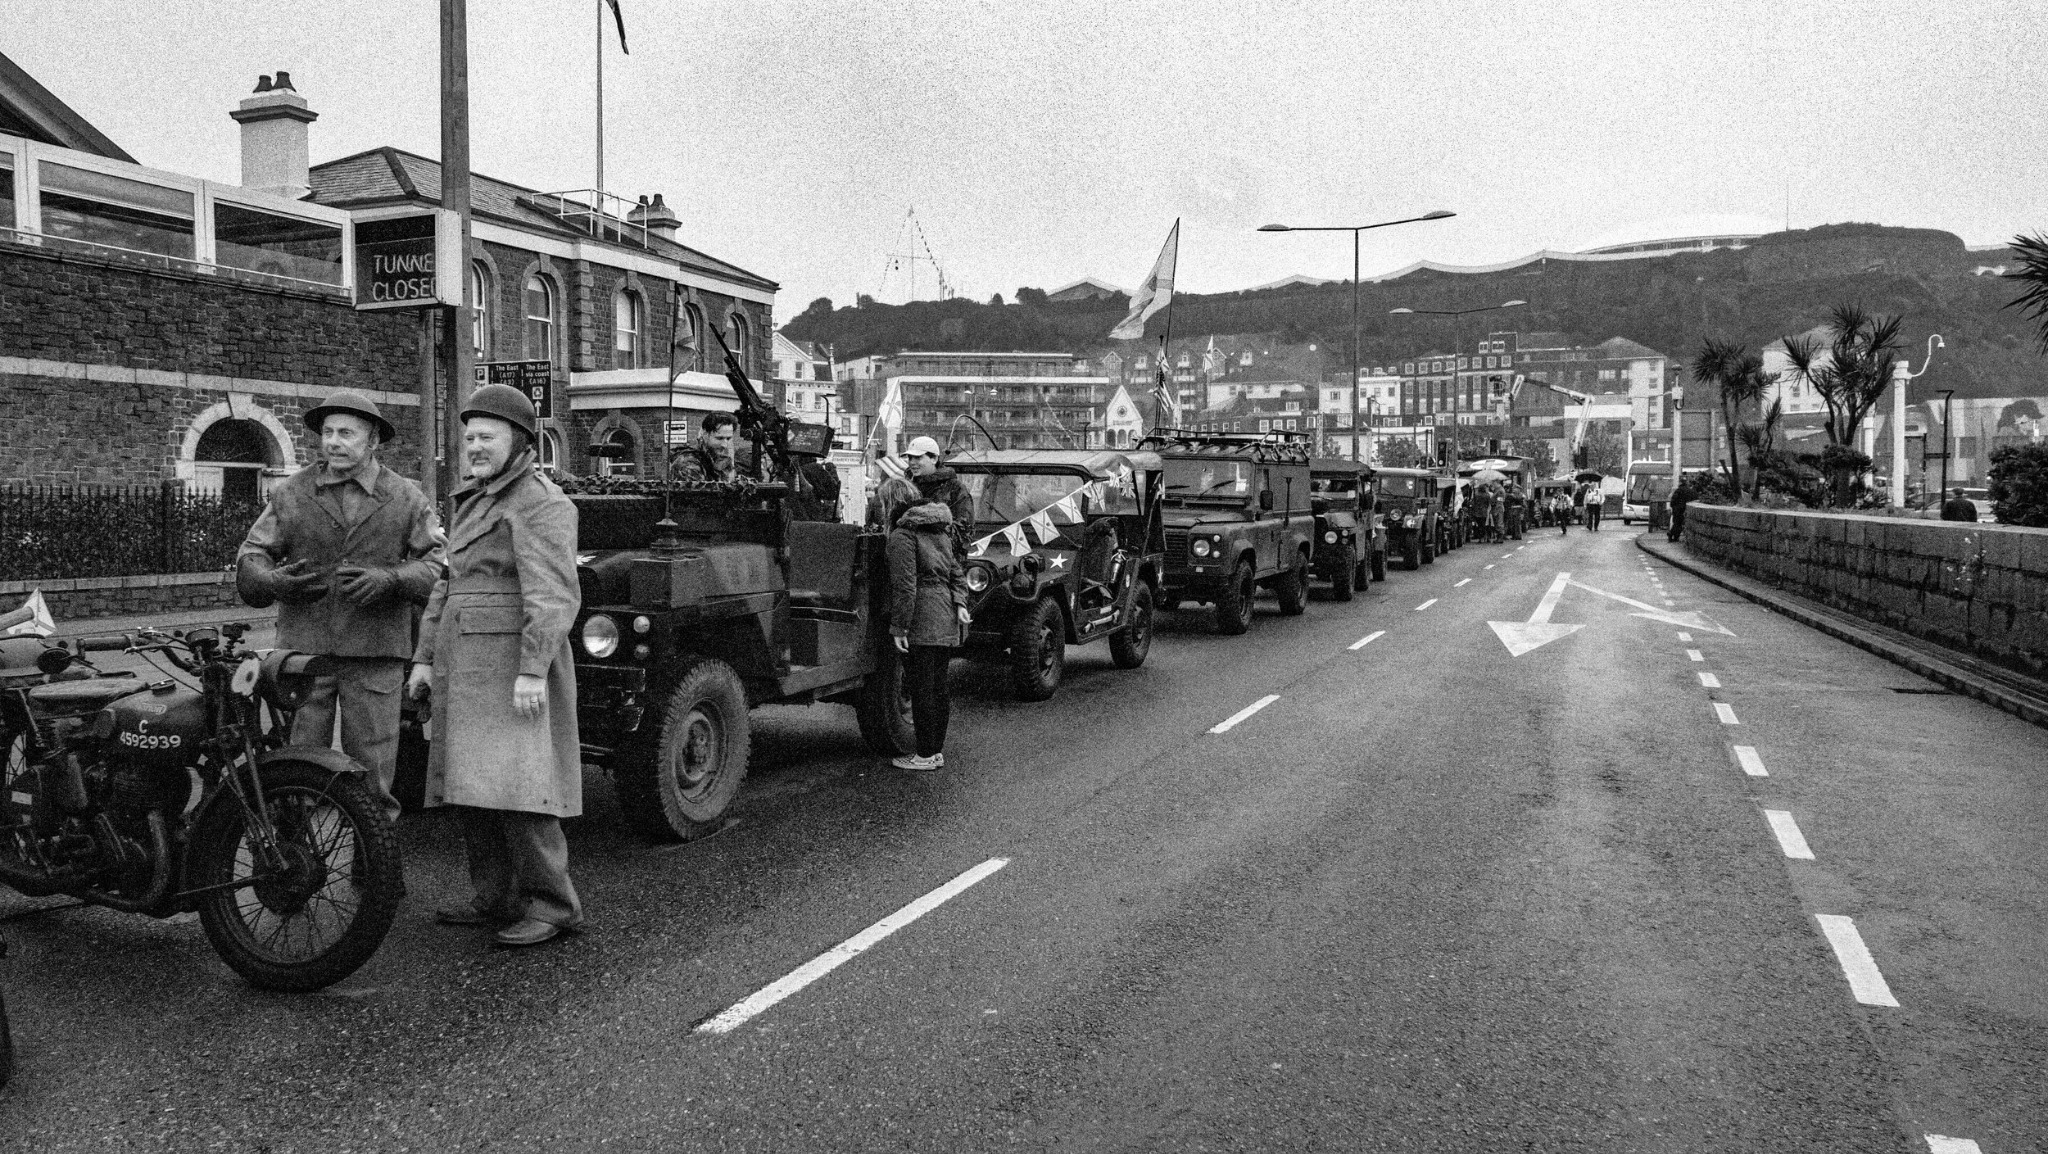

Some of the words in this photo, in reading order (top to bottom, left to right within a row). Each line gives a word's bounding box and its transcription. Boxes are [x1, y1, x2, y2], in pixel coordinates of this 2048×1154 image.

[373, 252, 436, 274] TUNNE
[138, 719, 149, 734] C
[120, 731, 182, 749] 4592939
